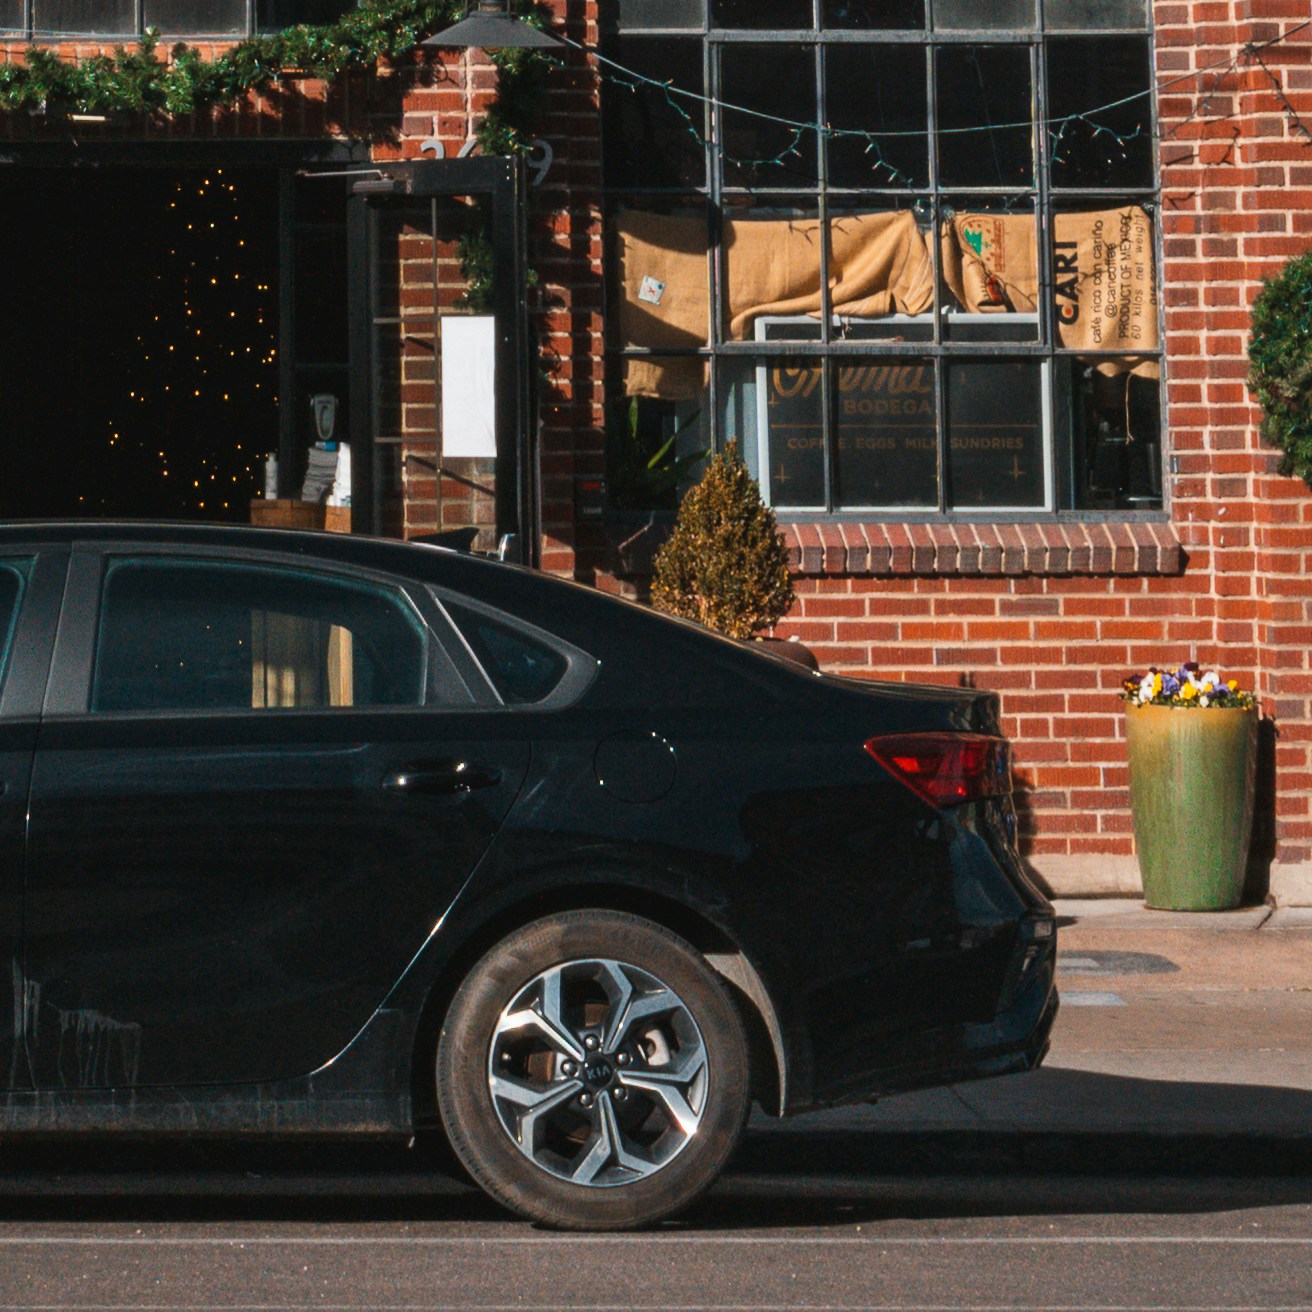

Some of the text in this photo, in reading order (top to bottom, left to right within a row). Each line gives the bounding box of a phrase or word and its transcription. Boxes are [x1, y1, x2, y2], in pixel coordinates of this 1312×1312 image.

[1055, 242, 1079, 325] CARI
[1092, 220, 1103, 343] café rico con cariño
[1119, 215, 1132, 338] PRODUCT OF MEXICO
[1131, 214, 1145, 340] 60 kilos net weight
[773, 366, 932, 397] Cma
[843, 399, 932, 415] BODEGA
[788, 437, 846, 449] COFFE
[855, 437, 896, 449] EGGS
[950, 437, 1024, 449] SUNDRIES
[587, 1065, 611, 1080] KIA
